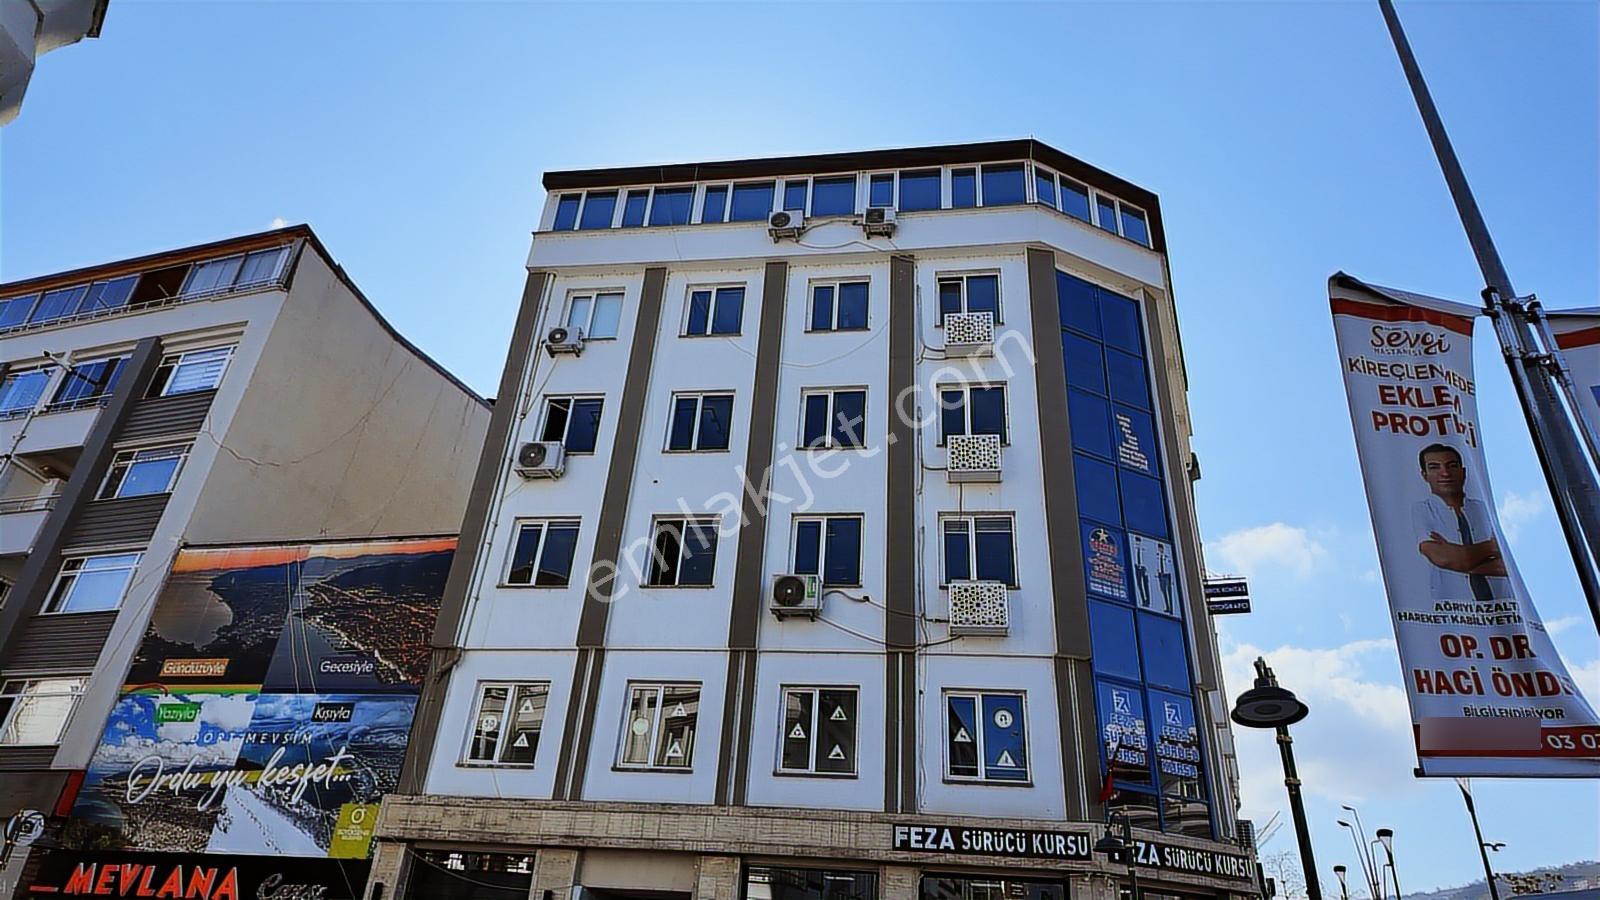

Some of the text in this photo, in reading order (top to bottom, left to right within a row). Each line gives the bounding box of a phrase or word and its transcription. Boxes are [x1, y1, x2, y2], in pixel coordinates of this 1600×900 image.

[1371, 325, 1451, 355] Sevgi
[1398, 611, 1448, 625] HAREKET
[1440, 634, 1484, 659] OP.
[320, 660, 374, 675] Gecesiyle
[1413, 665, 1485, 696] HACİ
[1463, 704, 1566, 720] BİLGİLENDİRİYOR
[245, 729, 312, 744] MEVSİM
[1547, 735, 1576, 750] 03
[895, 826, 1088, 856] FEZA SÜRÜCÜ KURSU
[1164, 846, 1212, 873] SÜRÜCÜ
[1215, 853, 1254, 878] KURSU
[63, 861, 240, 900] MEVLANA
